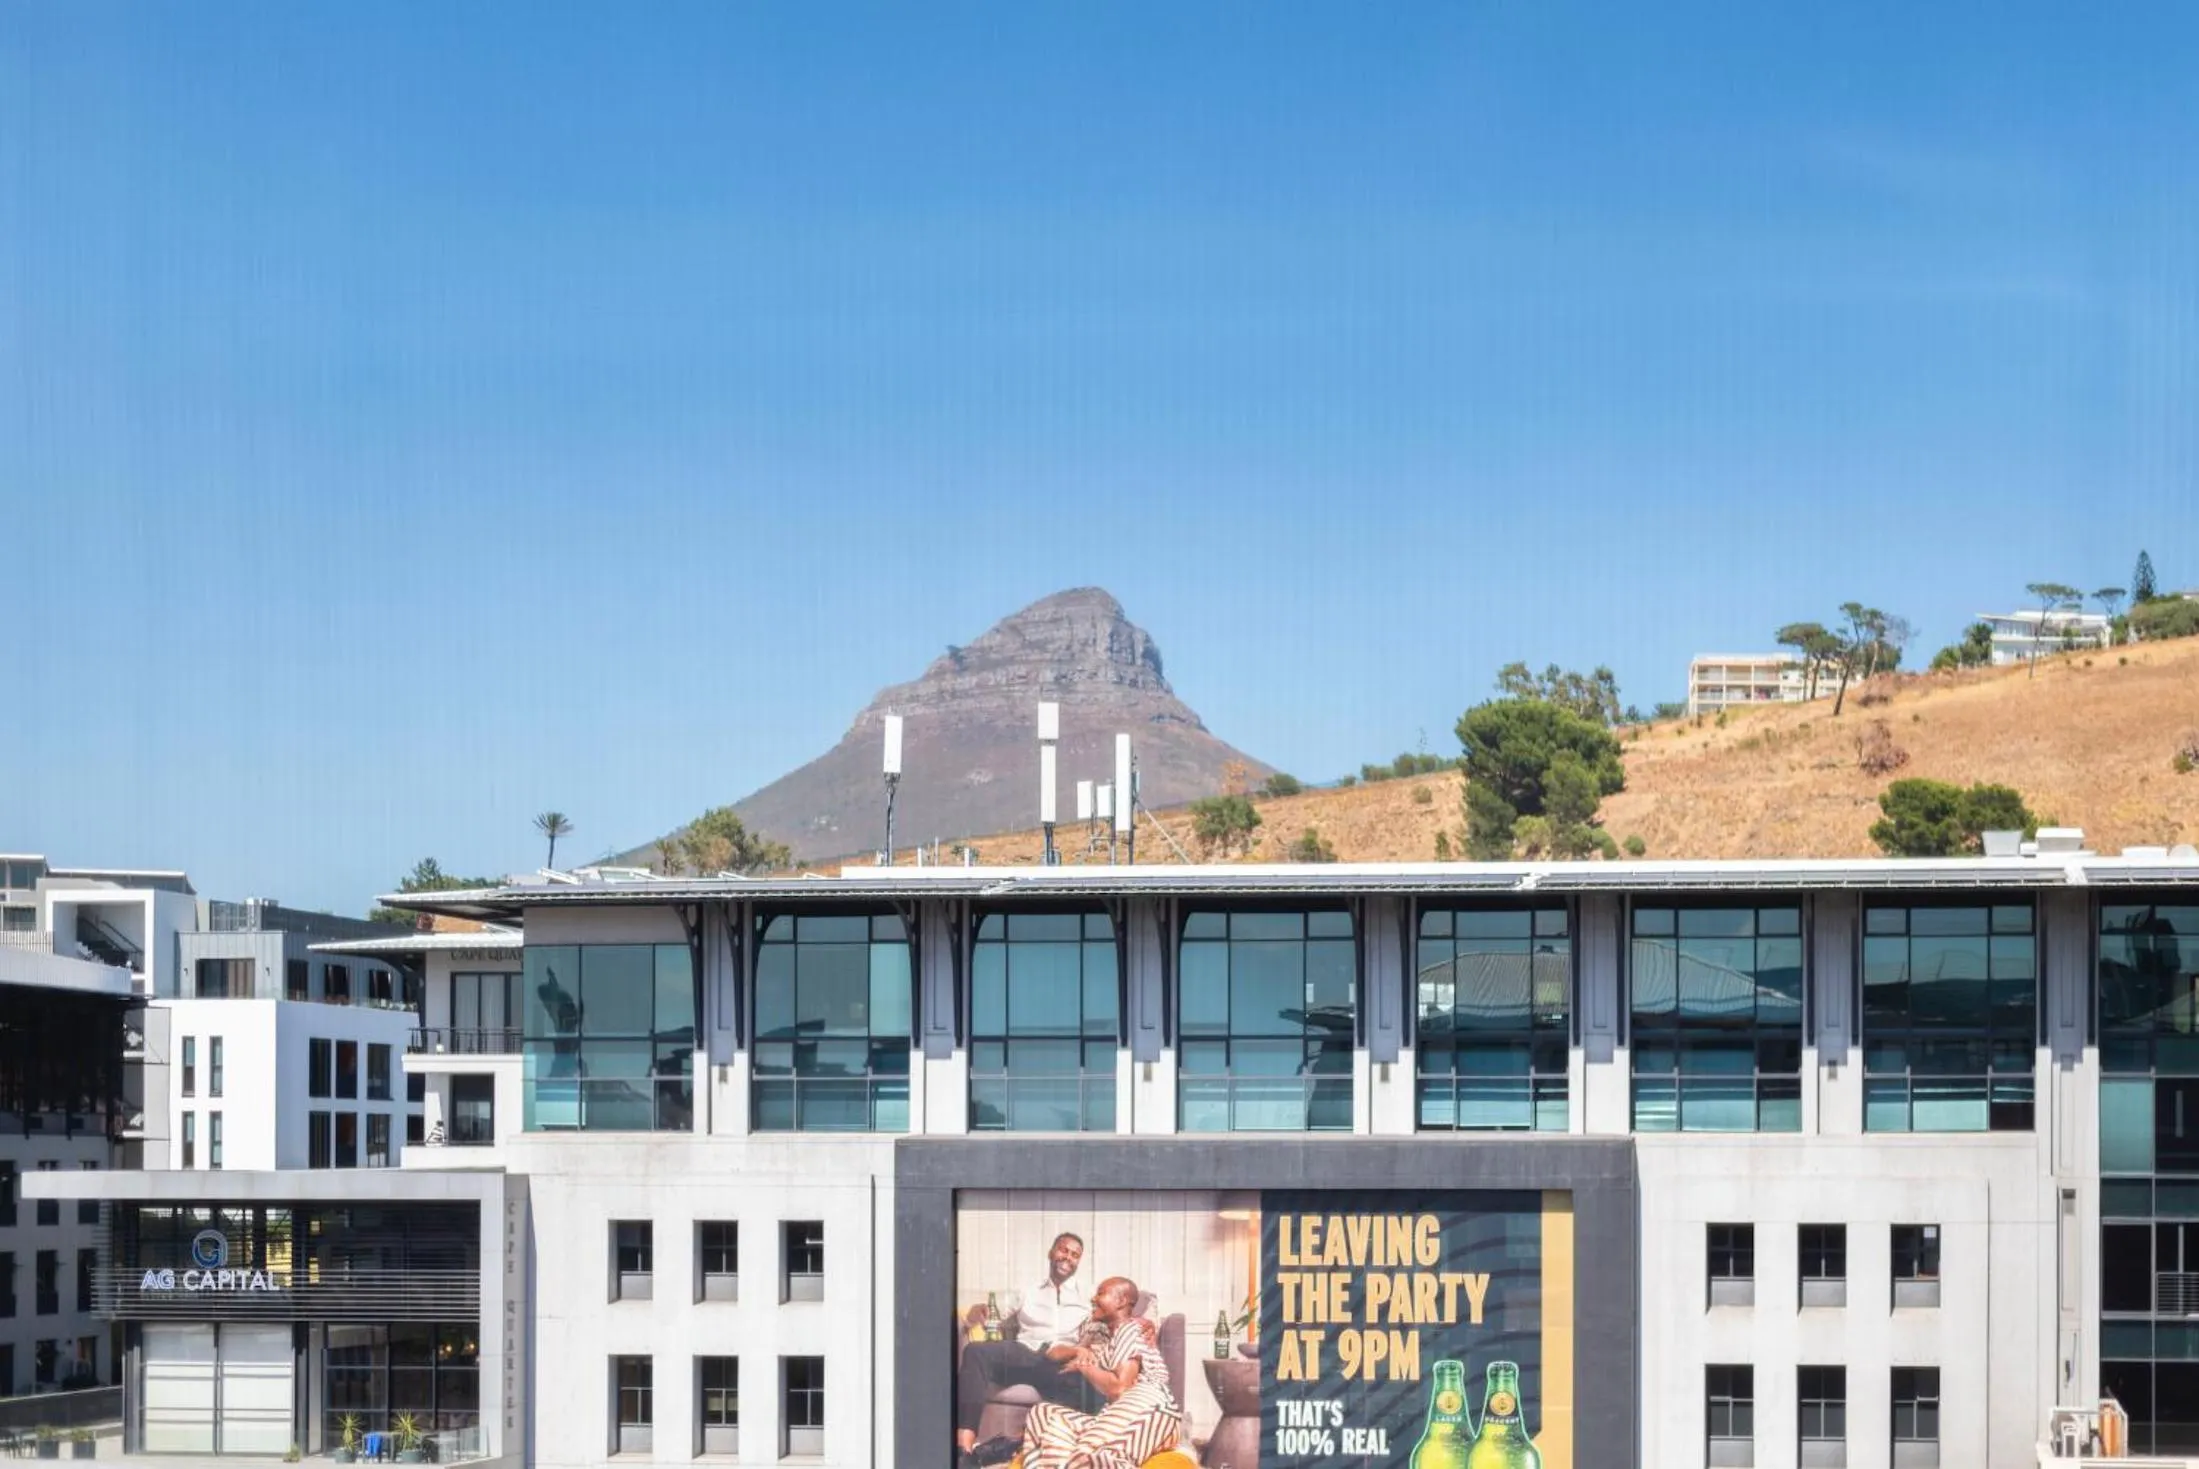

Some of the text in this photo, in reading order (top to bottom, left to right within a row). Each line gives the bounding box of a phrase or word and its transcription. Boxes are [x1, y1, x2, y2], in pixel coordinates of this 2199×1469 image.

[1279, 1214, 1441, 1266] LEAVING
[140, 1268, 280, 1291] AG CAPITAL
[1277, 1272, 1490, 1324] THE PARTY
[1276, 1329, 1420, 1381] AT 9PM
[1275, 1399, 1344, 1427] THAT'S
[1275, 1428, 1391, 1456] 100% REAL
